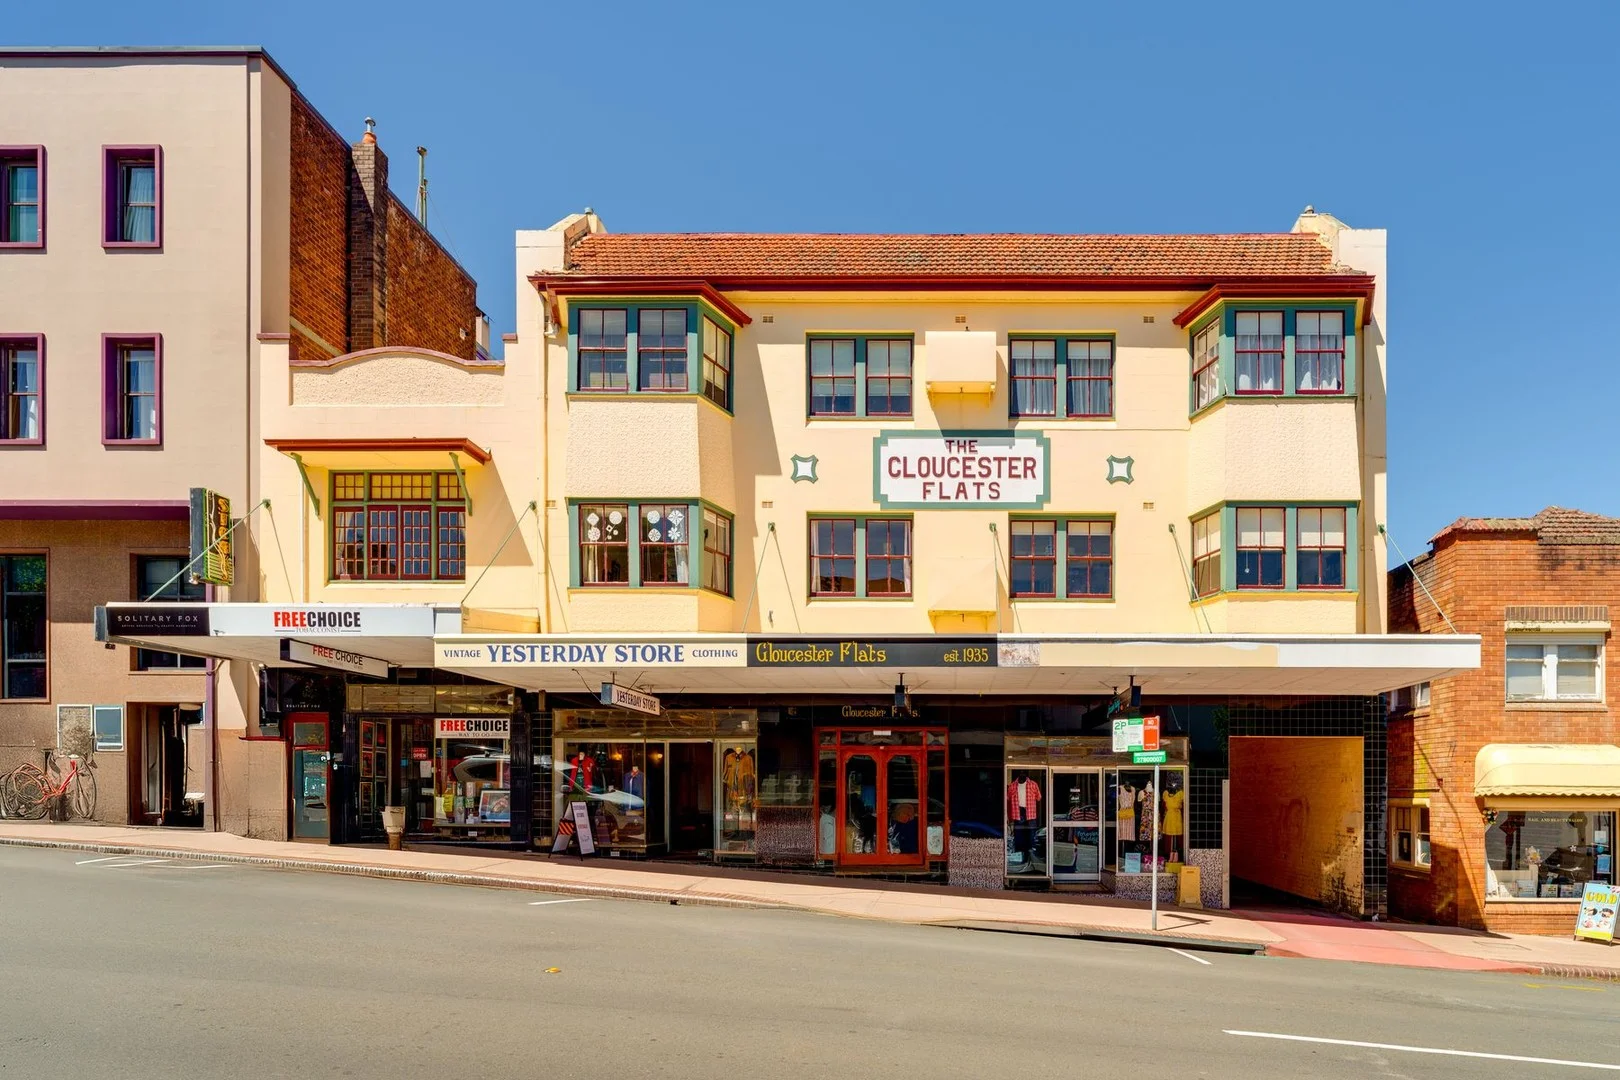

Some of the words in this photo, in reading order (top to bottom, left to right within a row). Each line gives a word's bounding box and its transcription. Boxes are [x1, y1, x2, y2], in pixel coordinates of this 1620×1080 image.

[945, 440, 978, 454] THE
[922, 481, 1001, 500] FLATS
[312, 645, 334, 659] FREE
[335, 651, 364, 666] CHOICE
[443, 648, 482, 658] VINTAGE
[486, 644, 608, 663] YESTERDAY
[614, 644, 685, 663] STORE
[691, 648, 739, 658] CLOTHING
[755, 643, 834, 663] Gloucester
[839, 641, 887, 663] Flats
[642, 698, 656, 712] STORE
[841, 705, 887, 718] Gloucester
[1114, 721, 1127, 731] 2P
[1585, 891, 1618, 905] GOLD
